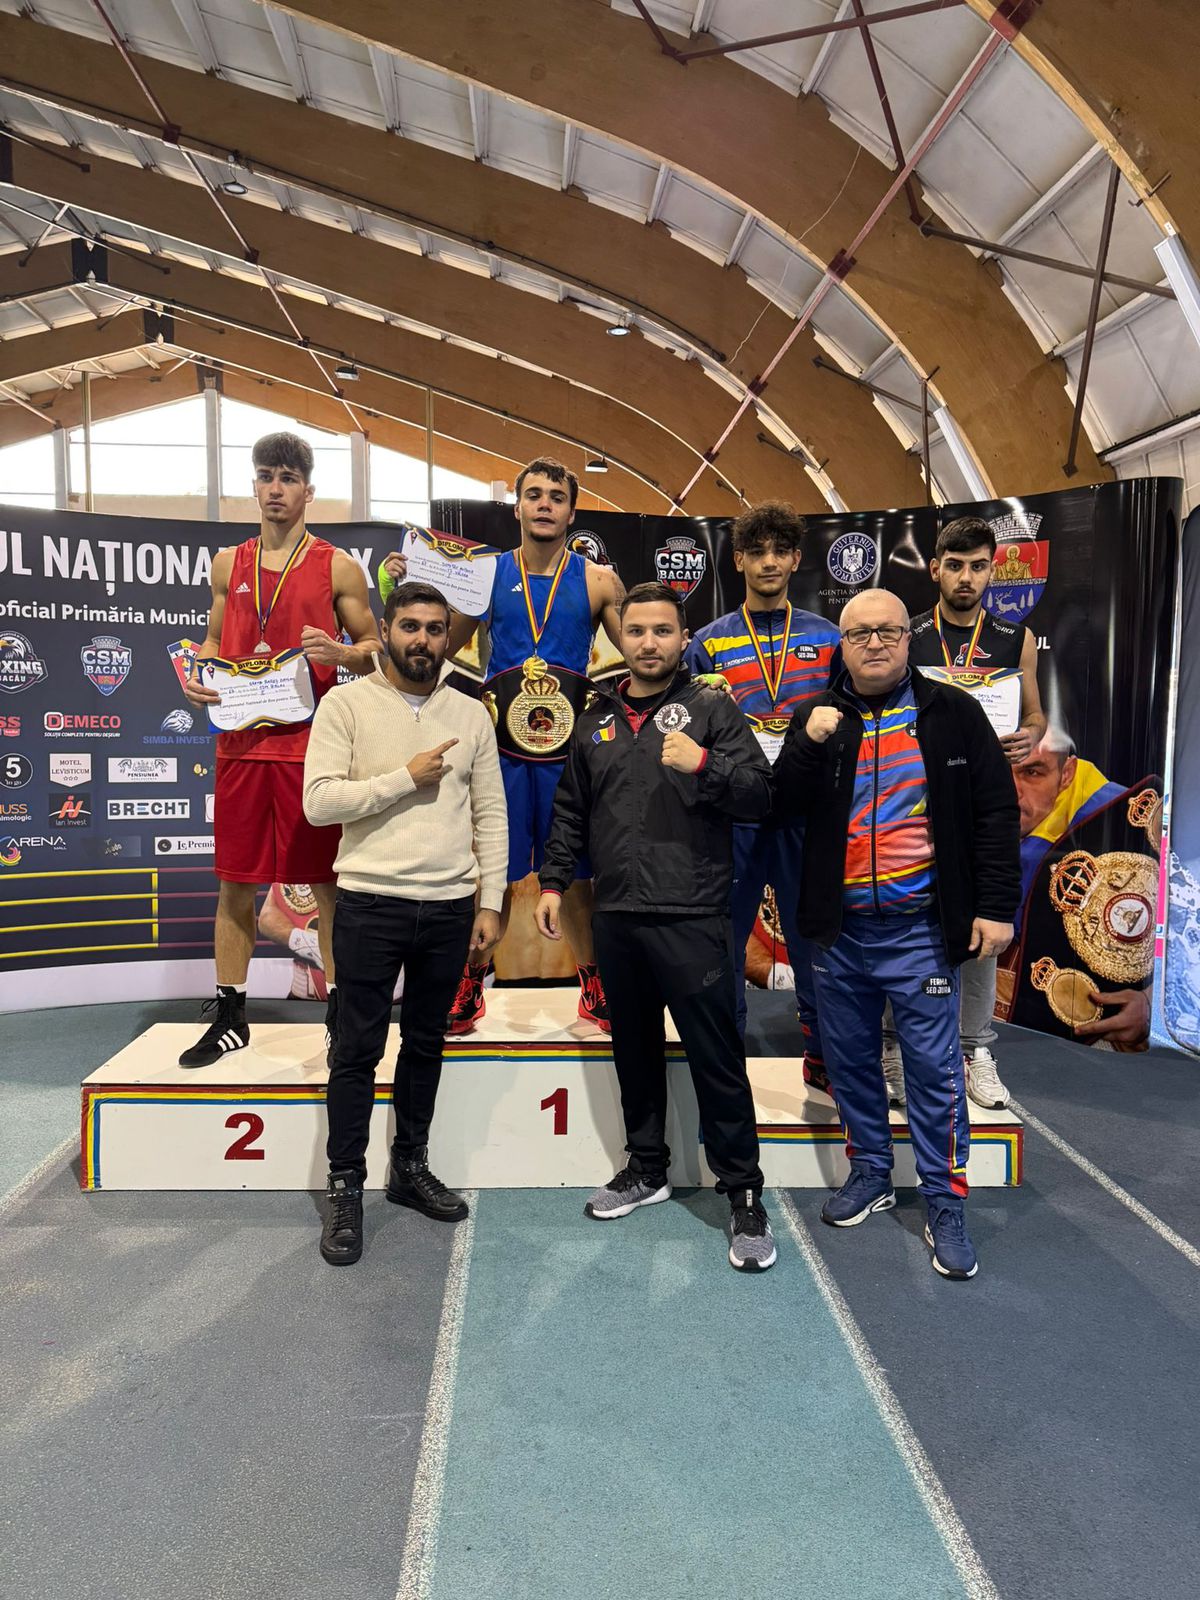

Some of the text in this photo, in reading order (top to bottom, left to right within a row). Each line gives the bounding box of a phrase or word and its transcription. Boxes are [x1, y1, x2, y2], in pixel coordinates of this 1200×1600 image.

[832, 535, 874, 554] GUVERNUL
[43, 535, 228, 596] NAȚIONA
[657, 552, 704, 570] CSM
[660, 570, 701, 580] BACAU
[62, 603, 145, 625] Primăria
[83, 650, 129, 665] CSM
[238, 660, 272, 669] DIPLOMA
[0, 660, 43, 675] XING
[86, 665, 127, 675] BACAU
[48, 714, 121, 729] DEMECO
[143, 736, 212, 744] SIMBA INVEST
[6, 757, 21, 778] 5
[109, 802, 188, 816] BRECHT
[7, 836, 66, 848] ARENA
[930, 978, 948, 986] FERMA
[541, 1088, 568, 1134] 1
[224, 1112, 265, 1160] 2
